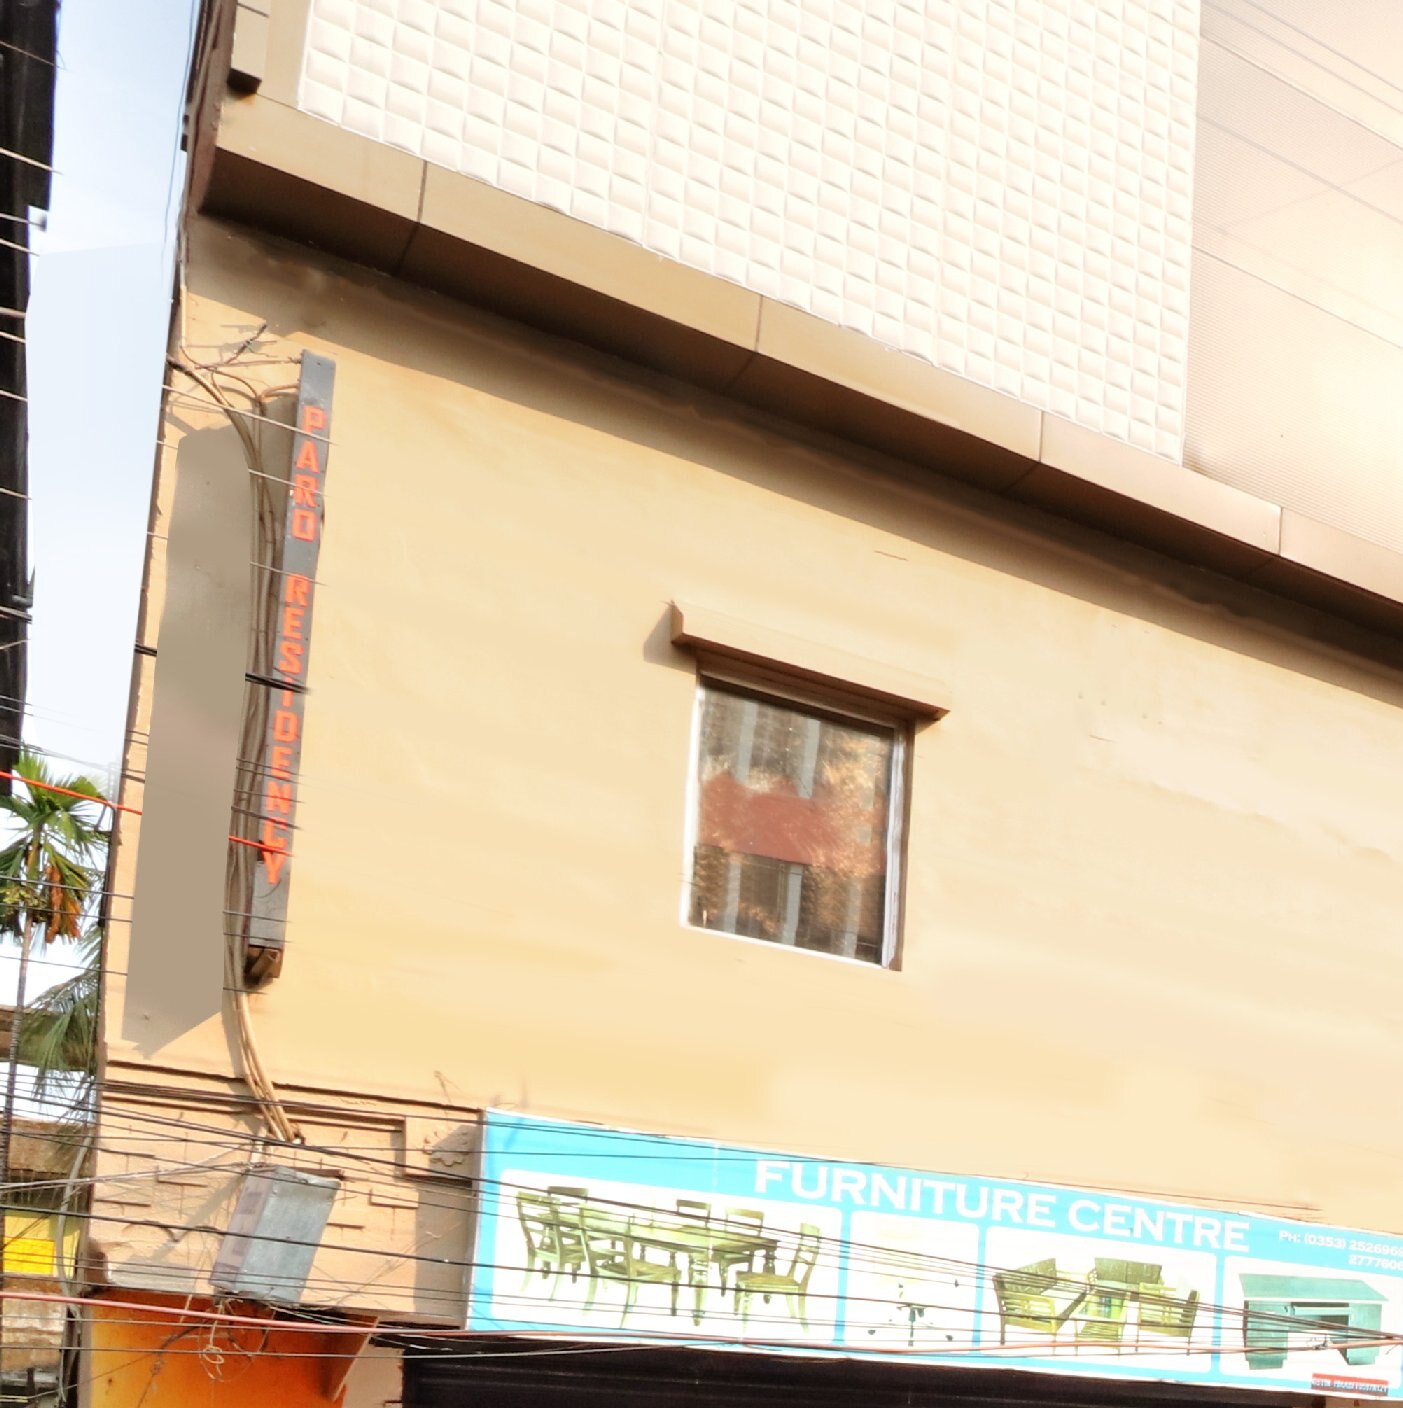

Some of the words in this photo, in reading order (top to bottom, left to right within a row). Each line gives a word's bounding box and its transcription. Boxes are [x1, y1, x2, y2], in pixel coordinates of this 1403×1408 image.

[291, 404, 326, 543] PARO
[262, 573, 309, 884] RESIDENCY
[754, 1159, 1057, 1229] FURNITURE
[1067, 1198, 1251, 1252] CENTRE
